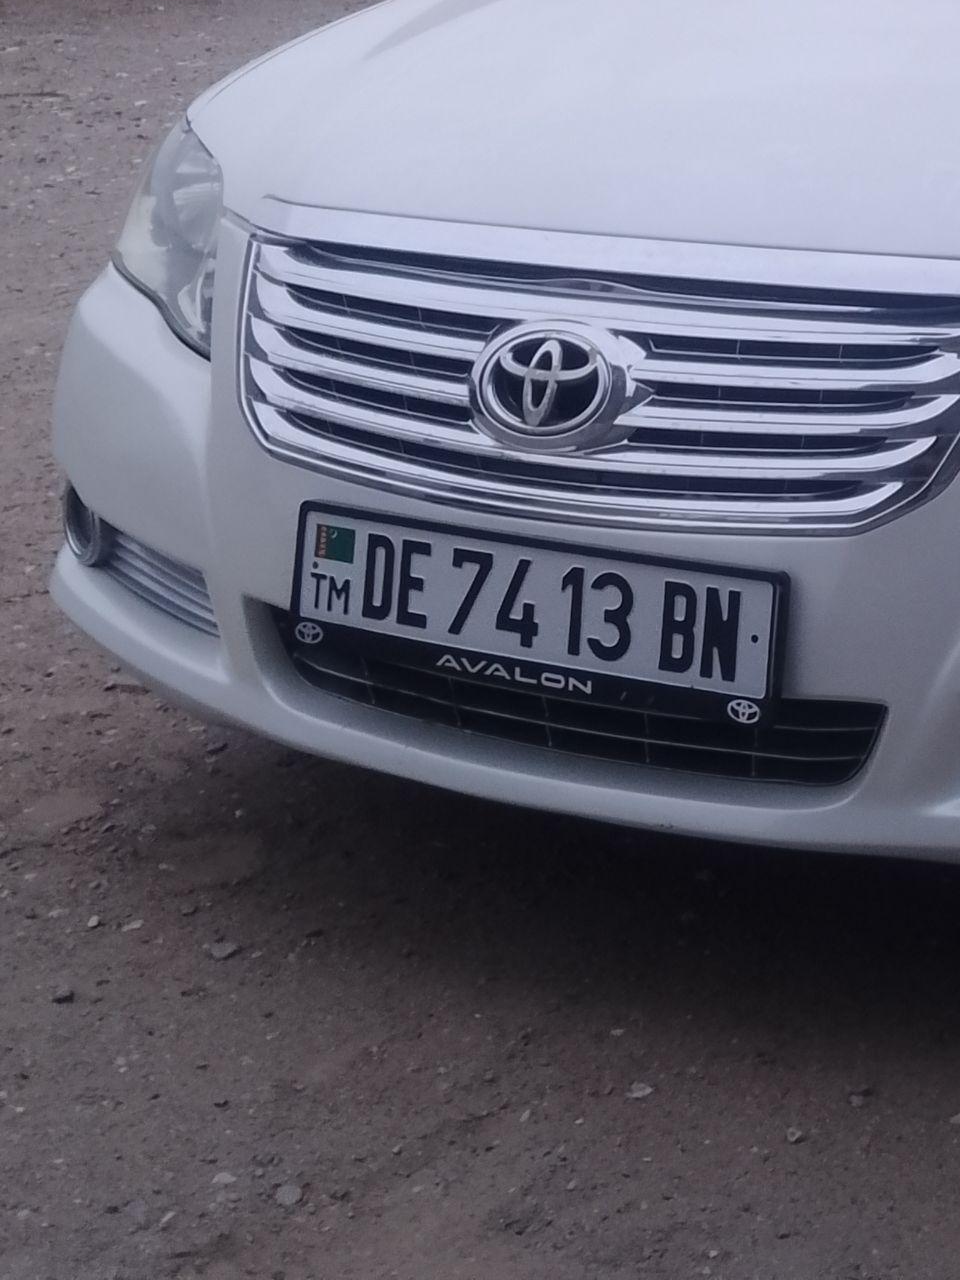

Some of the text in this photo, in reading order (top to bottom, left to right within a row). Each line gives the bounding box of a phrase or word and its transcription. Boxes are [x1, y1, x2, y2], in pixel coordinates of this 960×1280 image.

[310, 572, 351, 616] TM
[362, 533, 432, 629] DE
[658, 581, 742, 682] BN
[435, 653, 592, 695] AVALON
